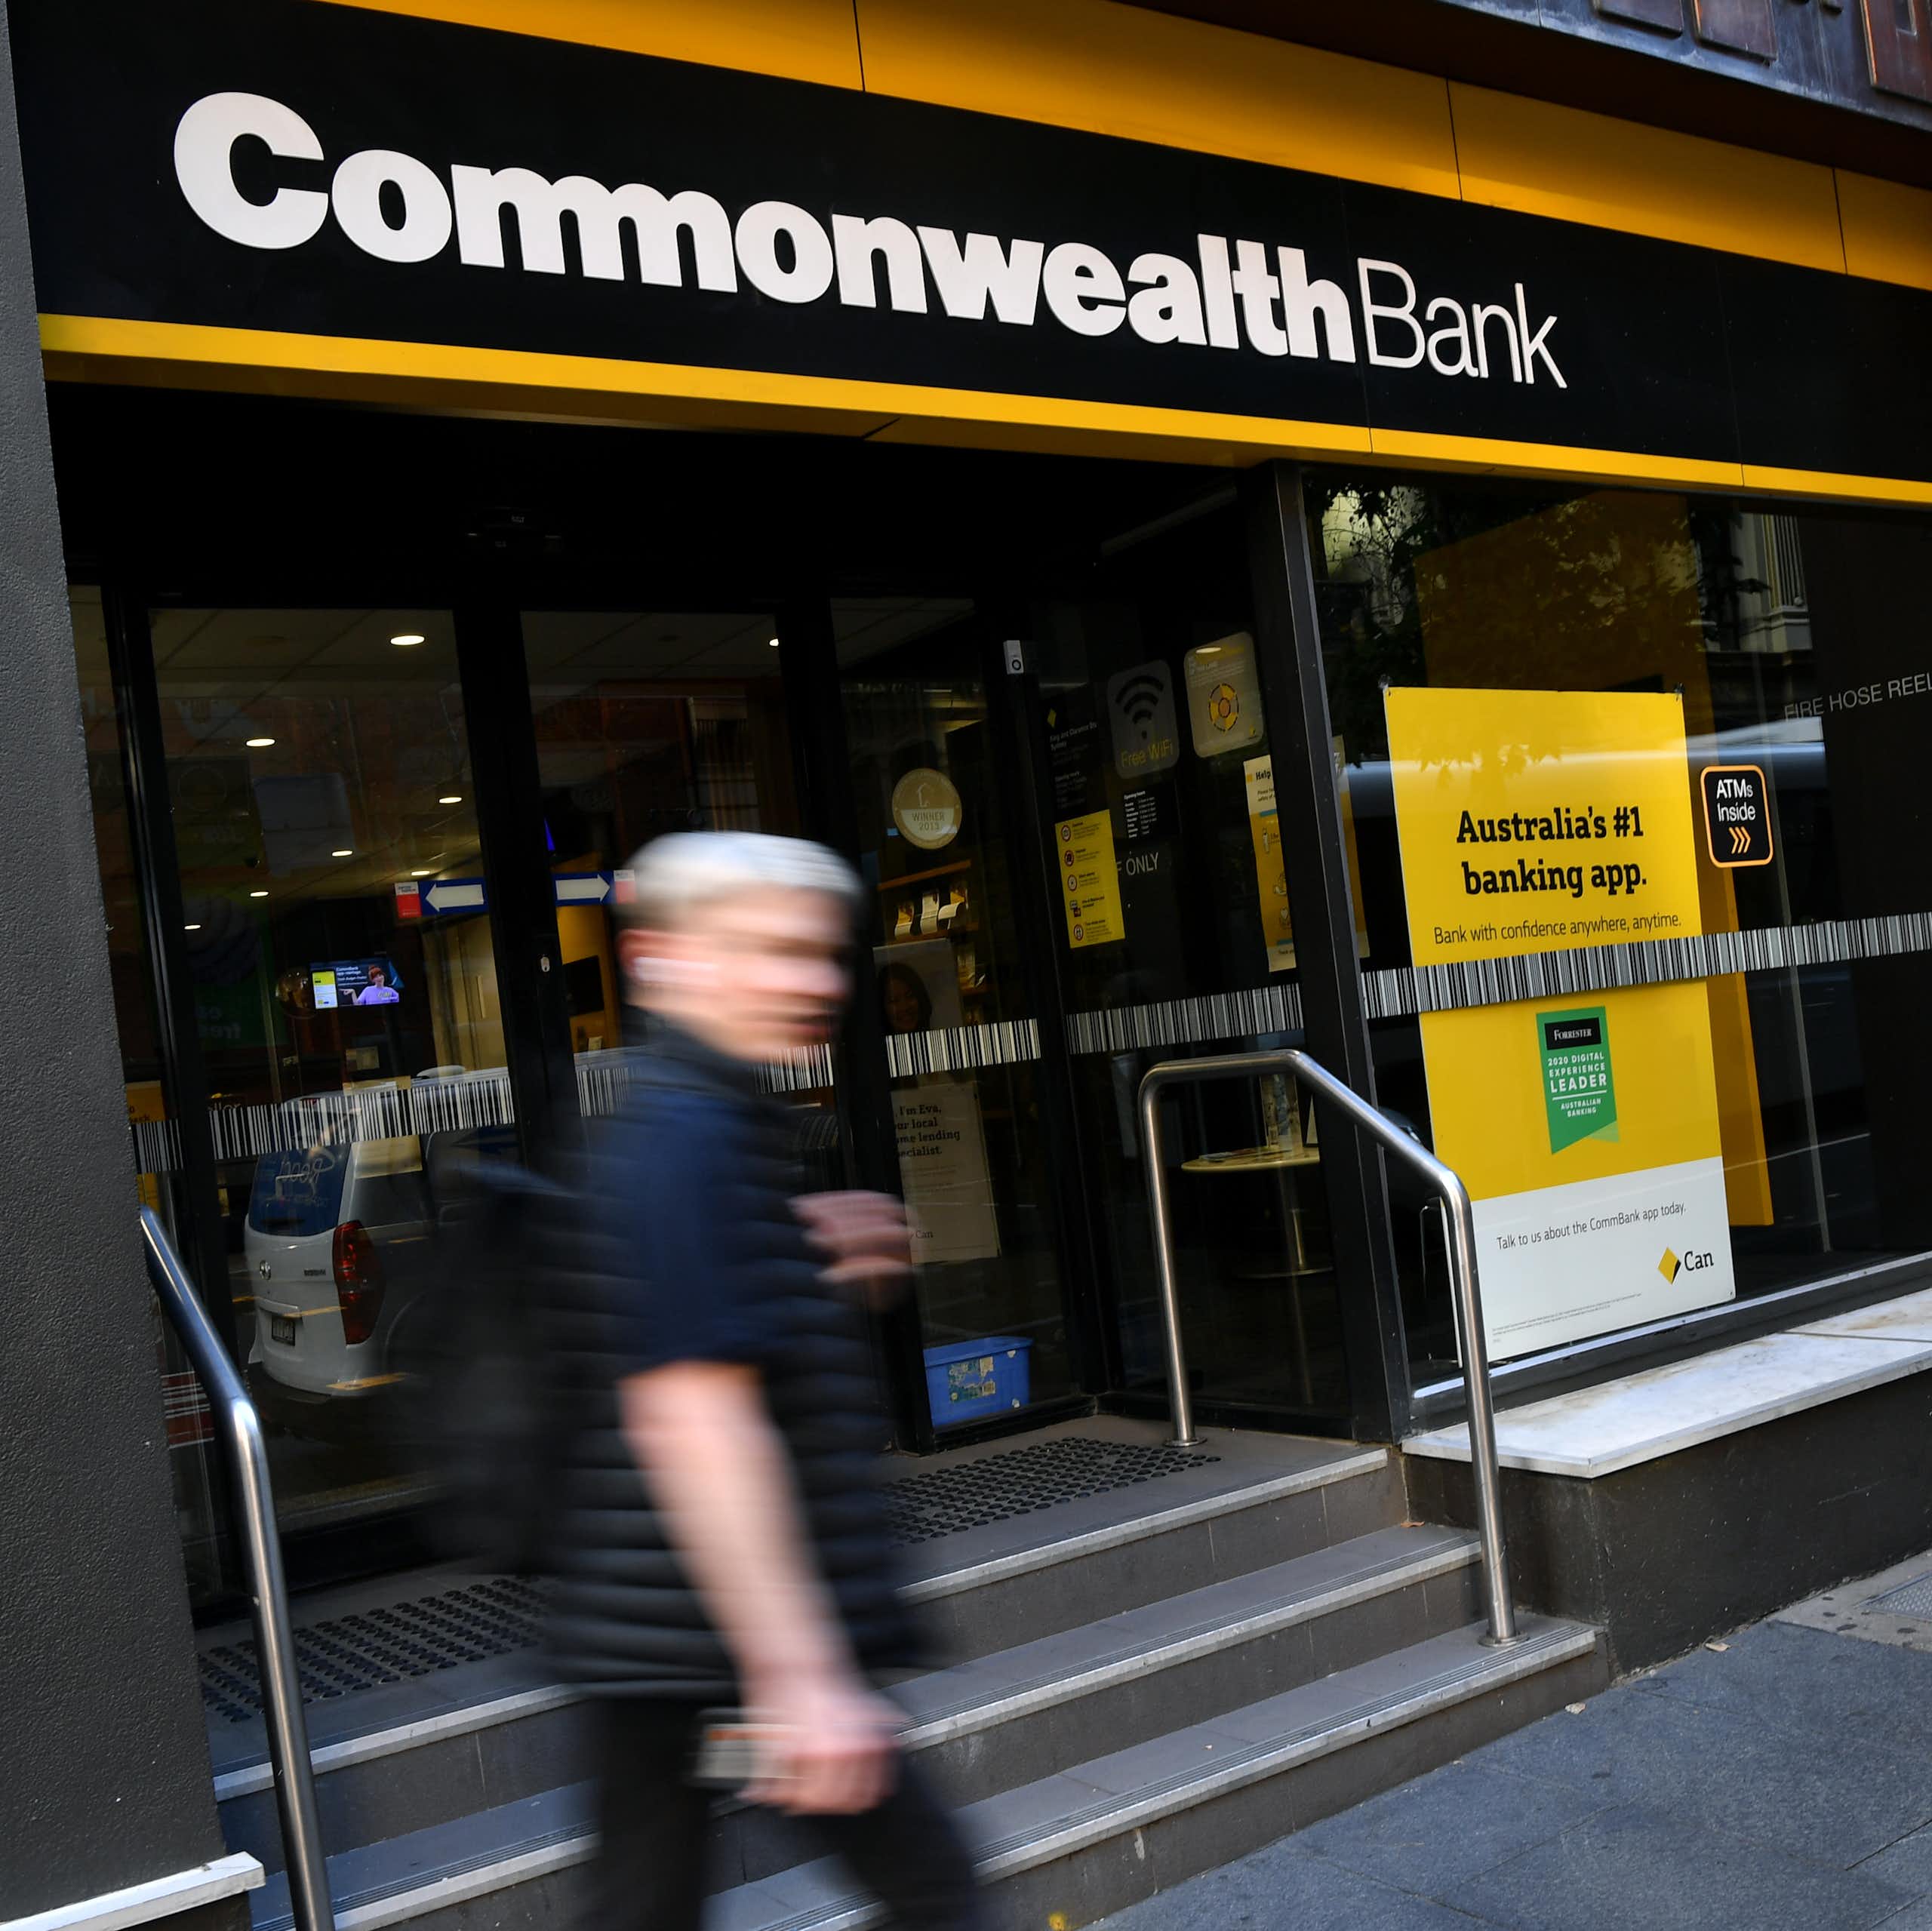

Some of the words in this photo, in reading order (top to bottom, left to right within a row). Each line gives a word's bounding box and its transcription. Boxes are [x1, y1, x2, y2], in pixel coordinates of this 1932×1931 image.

[174, 91, 1356, 363] Commonwealth
[1356, 257, 1569, 389] Bank
[1784, 697, 1823, 719] FIRE
[1829, 684, 1883, 712] HOSE
[1121, 749, 1147, 767] Free
[1716, 778, 1754, 799] ATMs
[912, 811, 945, 822] WINNER
[1717, 801, 1756, 822] Inside
[1457, 806, 1607, 843] Australia's
[1613, 806, 1644, 837] #1
[1126, 852, 1159, 876] ONLY
[1462, 859, 1583, 899] banking
[1591, 862, 1647, 895] app.
[1434, 925, 1467, 945] Bank
[1471, 921, 1497, 941] with
[1501, 919, 1567, 939] confidence
[1570, 915, 1630, 935] anywhere,
[1632, 912, 1682, 932] anytime.
[1547, 1056, 1569, 1067] 2020
[1571, 1052, 1604, 1064] DIGITAL
[1549, 1062, 1606, 1078] EXPERIENCE
[1551, 1074, 1607, 1093] LEADER
[900, 1105, 917, 1116] I'm
[1561, 1098, 1601, 1110] AUSTRALIAN
[1567, 1108, 1597, 1118] BANKING
[912, 1117, 937, 1129] local
[918, 1130, 961, 1142] lending
[915, 1229, 934, 1239] Can
[1497, 1235, 1516, 1250] Talk
[1518, 1234, 1528, 1246] to
[1531, 1231, 1542, 1243] us
[1544, 1226, 1571, 1241] about
[1573, 1222, 1588, 1235] the
[1589, 1210, 1640, 1231] CommBank
[1642, 1209, 1659, 1220] app
[1661, 1201, 1687, 1218] today.
[1684, 1250, 1715, 1271] Can
